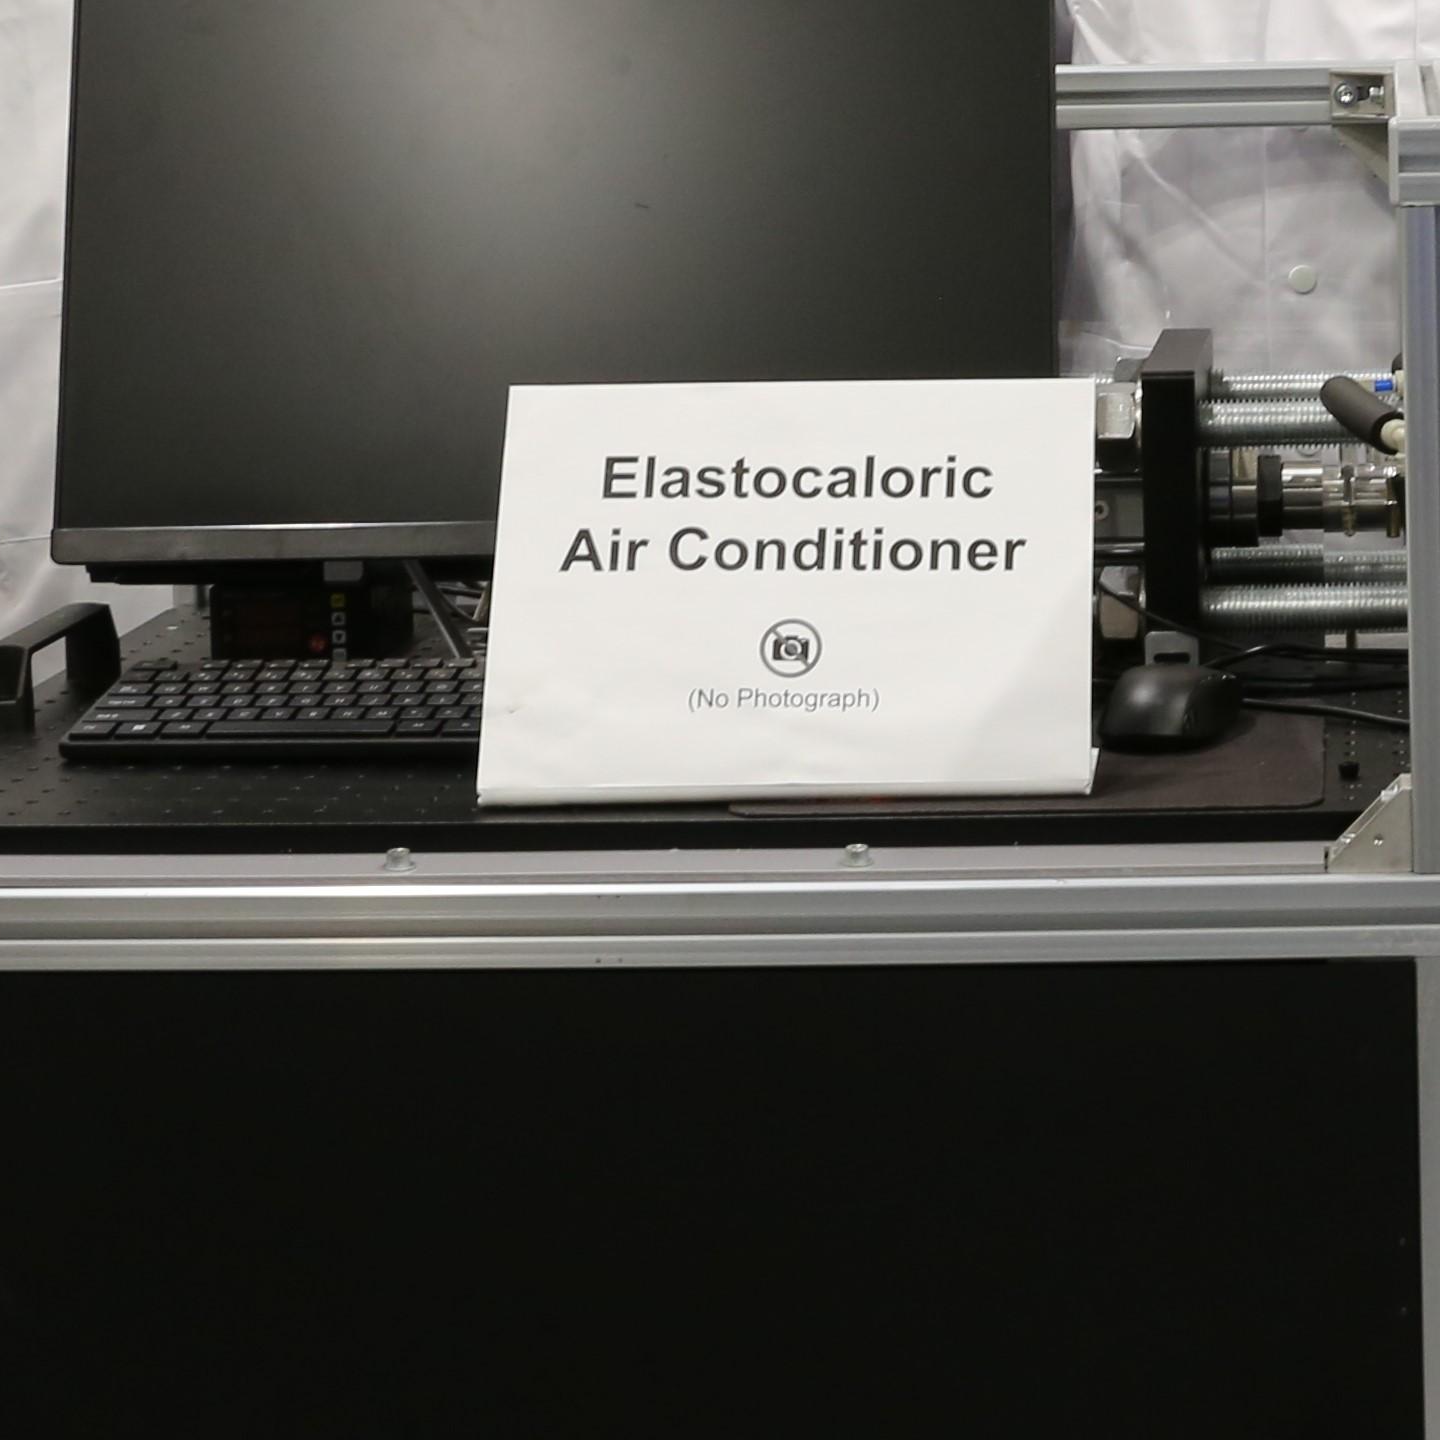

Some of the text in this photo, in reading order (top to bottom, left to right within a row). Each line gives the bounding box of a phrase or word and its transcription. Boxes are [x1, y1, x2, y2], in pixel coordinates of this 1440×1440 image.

[601, 455, 994, 499] Elastocaloric
[559, 526, 1026, 571] Air Conditioner
[687, 687, 880, 712] (No Photograph)
